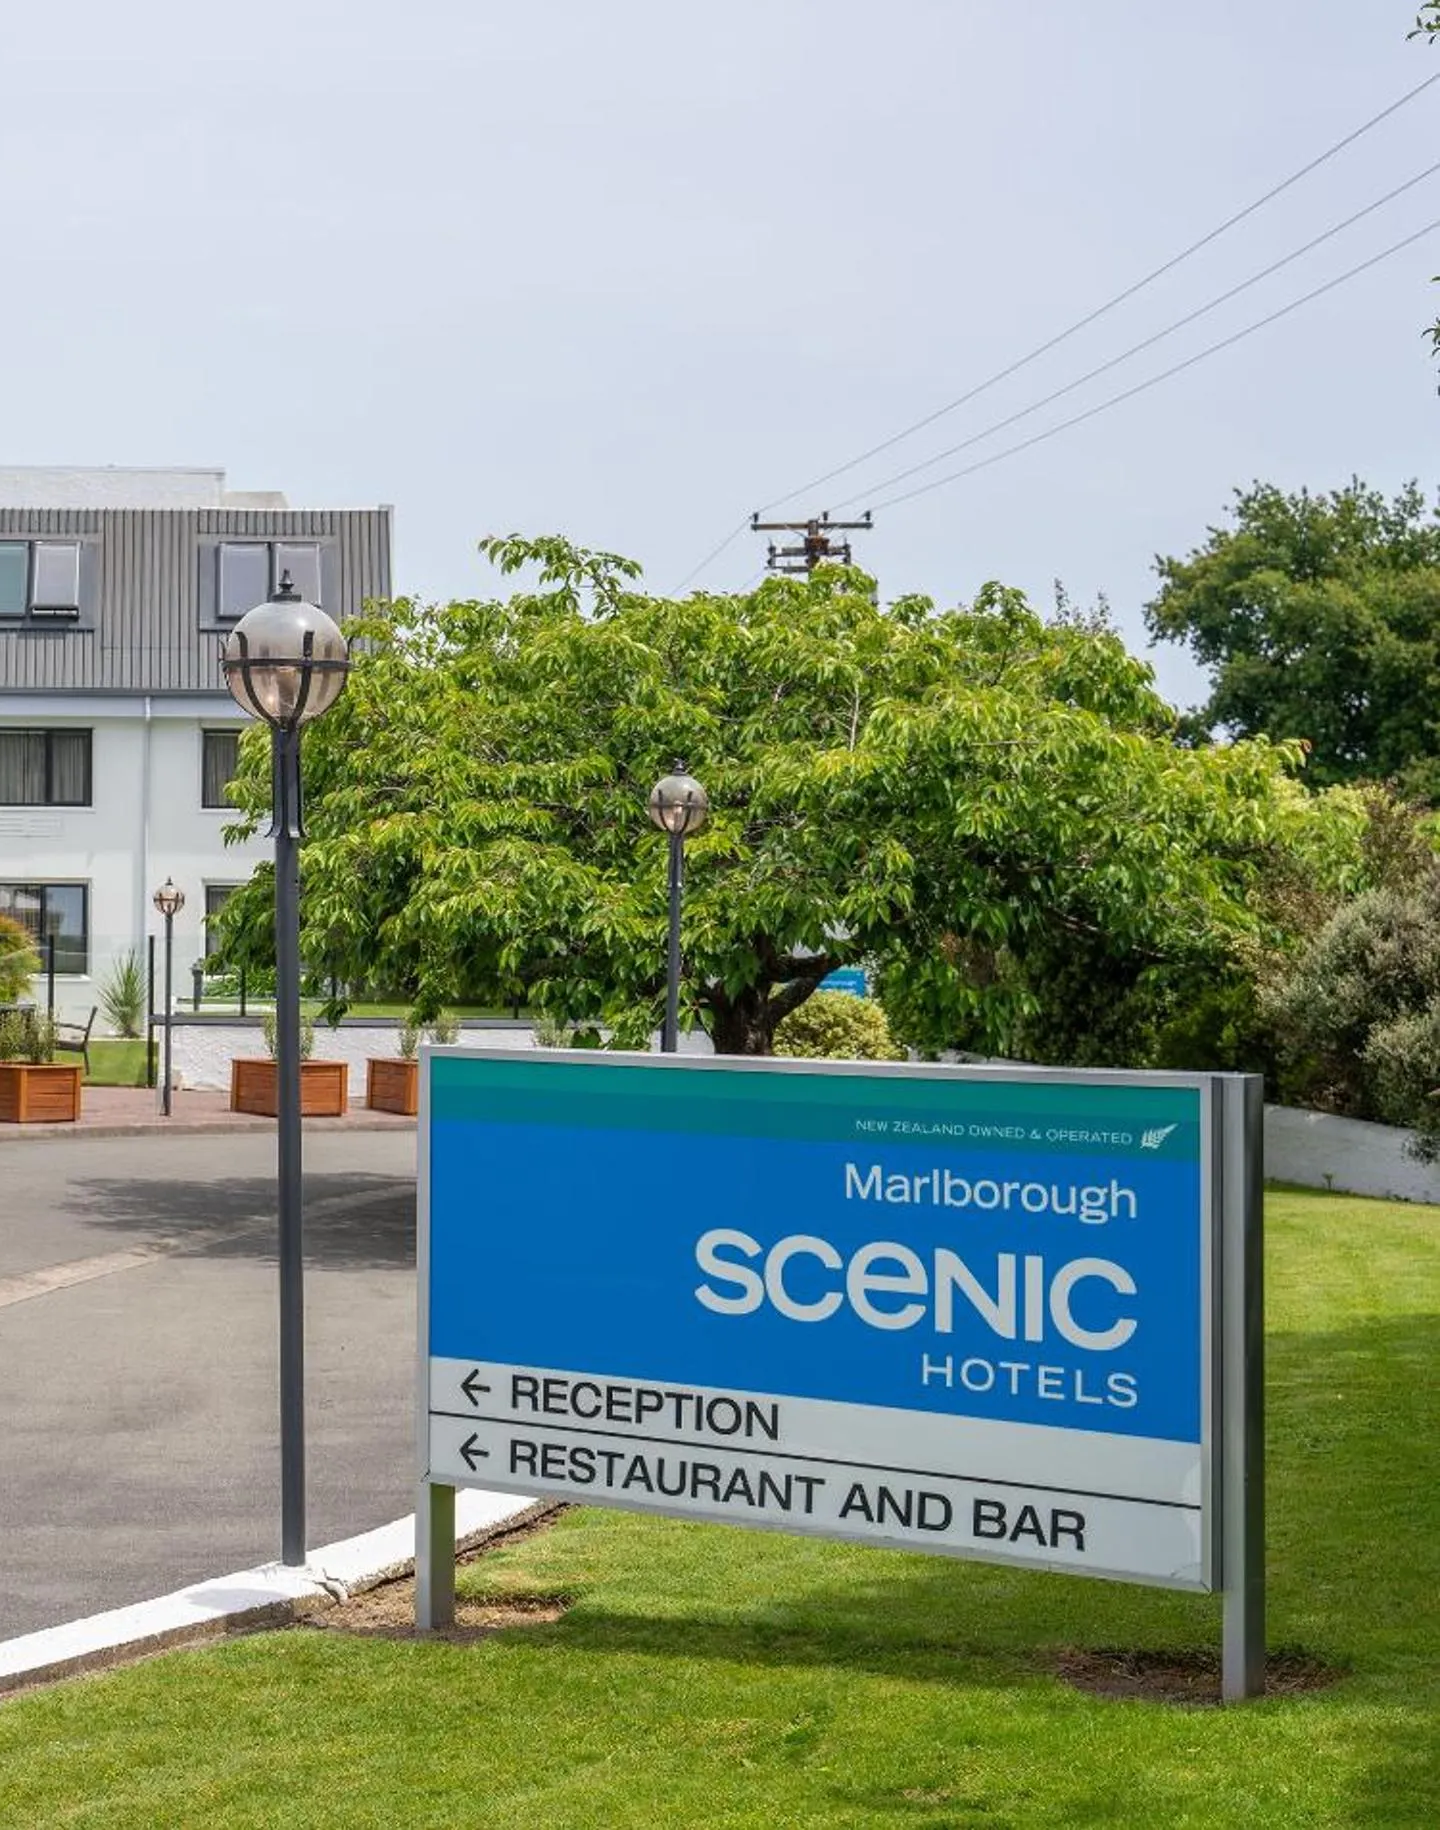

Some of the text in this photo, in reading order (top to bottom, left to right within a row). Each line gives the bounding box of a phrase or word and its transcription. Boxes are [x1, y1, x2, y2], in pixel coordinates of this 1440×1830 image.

[855, 1119, 1133, 1145] NEW ZEALAND OWNED & OPERATED
[845, 1162, 1137, 1225] Marlborough
[510, 1373, 780, 1442] RECEPTION
[921, 1353, 1138, 1408] HOTELS
[508, 1438, 1087, 1554] RESTAURANT AND BAR
